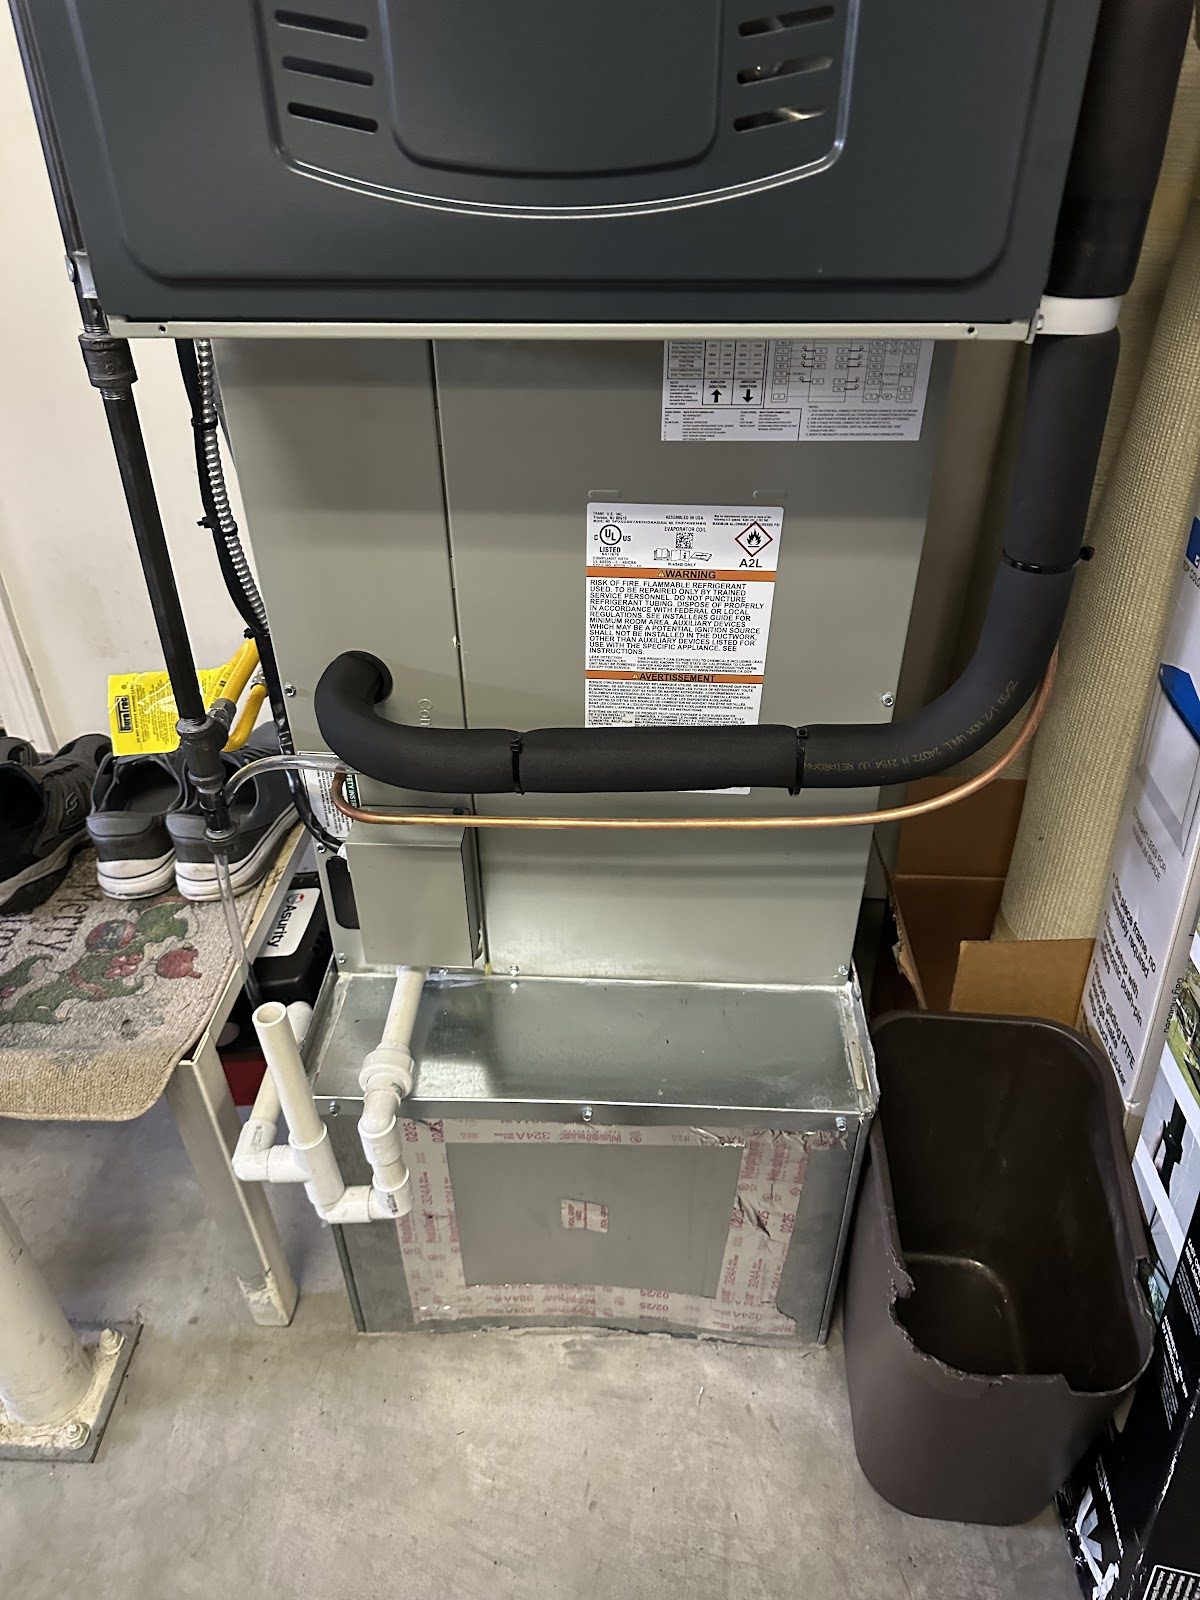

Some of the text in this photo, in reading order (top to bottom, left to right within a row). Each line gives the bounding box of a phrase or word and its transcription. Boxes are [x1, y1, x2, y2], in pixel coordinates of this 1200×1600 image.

[664, 570, 716, 579] WARNING
[739, 559, 762, 568] A2L
[640, 673, 715, 682] AVERTISSEMENT
[28, 889, 101, 952] Merry
[268, 904, 297, 948] Asurity
[1128, 934, 1150, 980] required
[1130, 921, 1151, 959] frame,
[1147, 956, 1158, 973] no
[1126, 972, 1141, 999] with
[1120, 982, 1144, 1027] push-pin
[1103, 1002, 1124, 1041] gliding
[1120, 1035, 1137, 1071] PTFE
[404, 1121, 418, 1142] 02/25
[429, 1119, 445, 1143] 02/25
[515, 1132, 550, 1140] 324A
[420, 1184, 433, 1205] 324A
[780, 1213, 795, 1233] 02/25
[640, 1290, 669, 1298] 02/25
[733, 1311, 762, 1319] 324A
[1110, 1502, 1124, 1559] STORAGE
